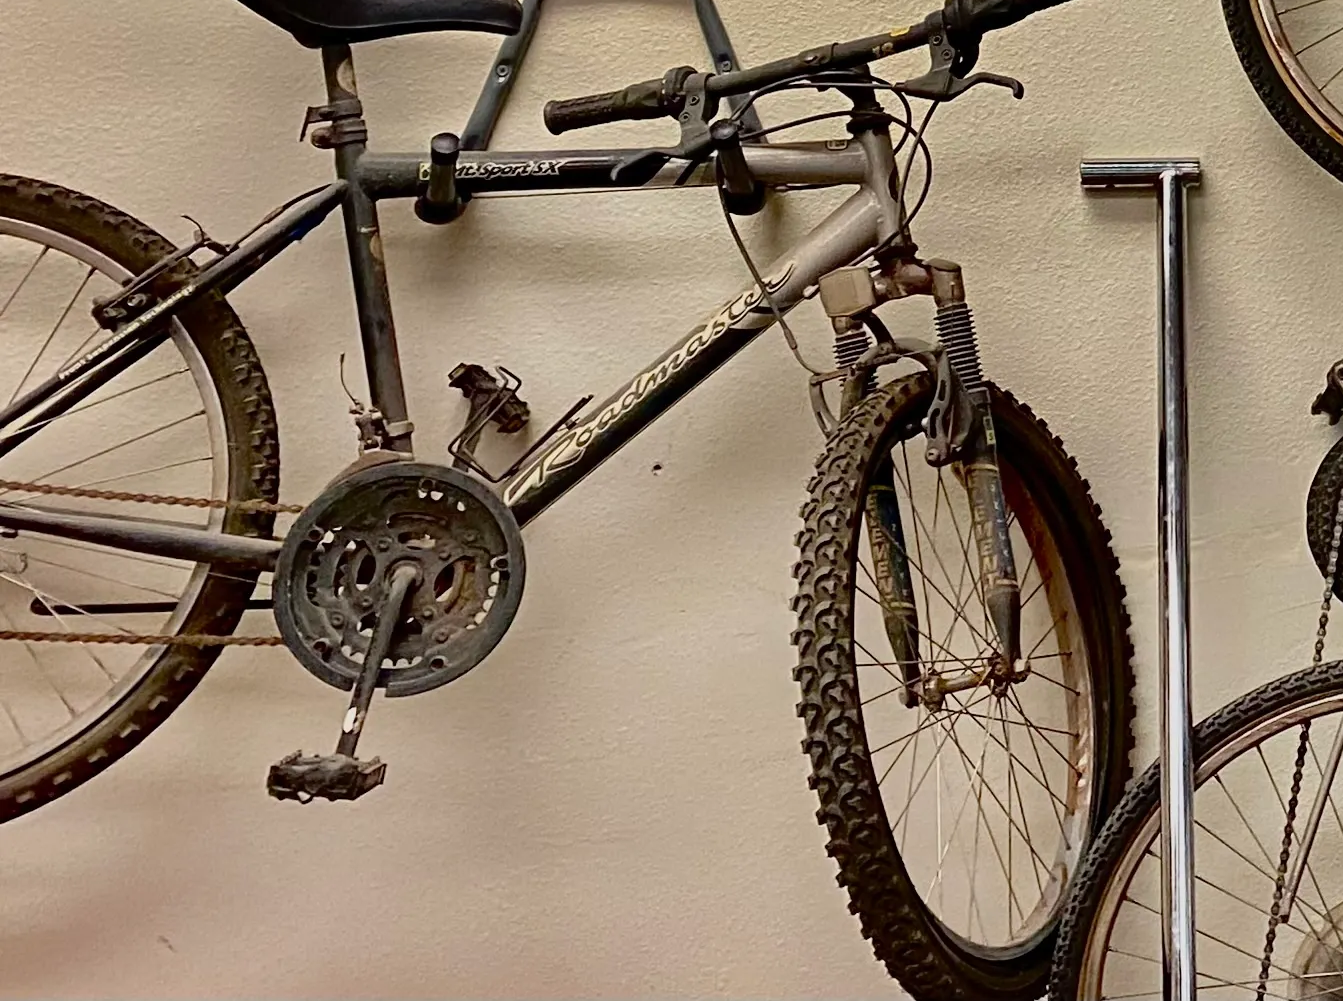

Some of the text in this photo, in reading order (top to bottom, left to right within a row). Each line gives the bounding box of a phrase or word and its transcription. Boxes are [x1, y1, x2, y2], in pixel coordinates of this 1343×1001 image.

[480, 161, 530, 181] Sport
[532, 160, 567, 175] SX
[503, 261, 797, 507] Roadmaster
